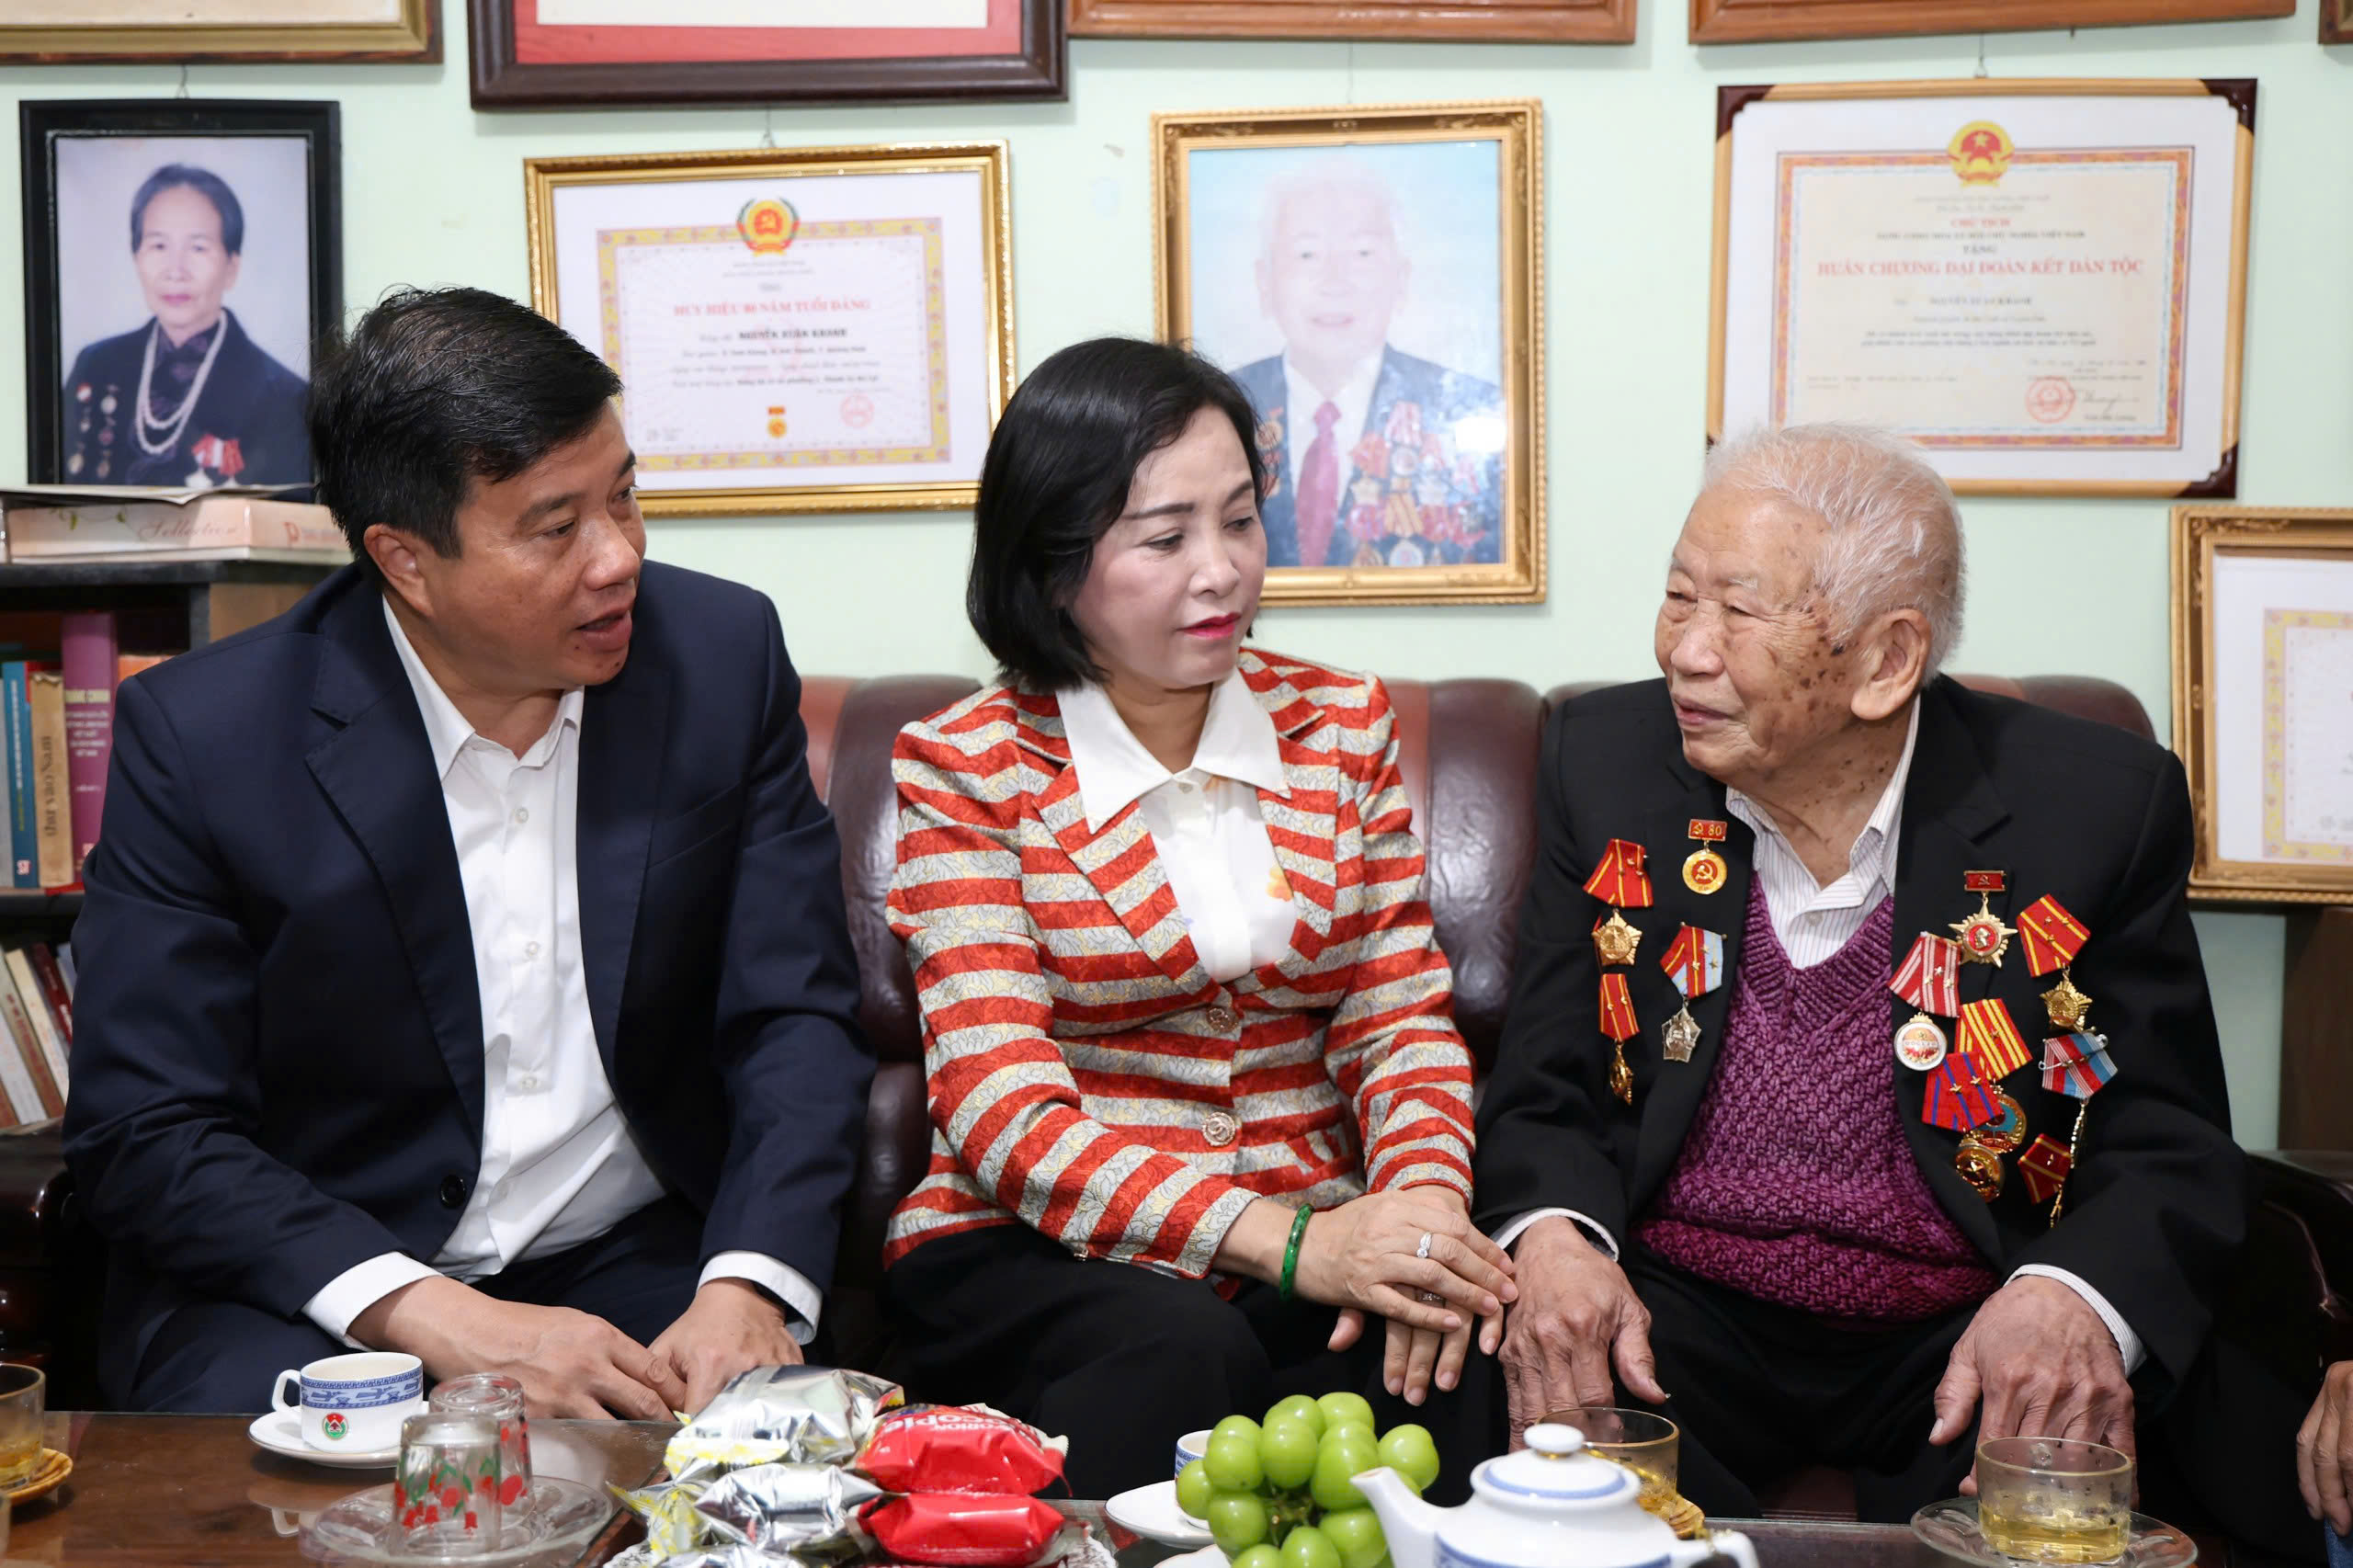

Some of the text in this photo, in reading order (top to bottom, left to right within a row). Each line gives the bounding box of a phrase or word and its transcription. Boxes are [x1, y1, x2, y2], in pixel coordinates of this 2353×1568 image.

[1817, 257, 1864, 277] HUÂN
[1869, 258, 1941, 278] CHƯƠNG
[2031, 253, 2063, 275] KẾT
[2110, 255, 2143, 278] TỘC
[1708, 824, 1722, 836] 80
